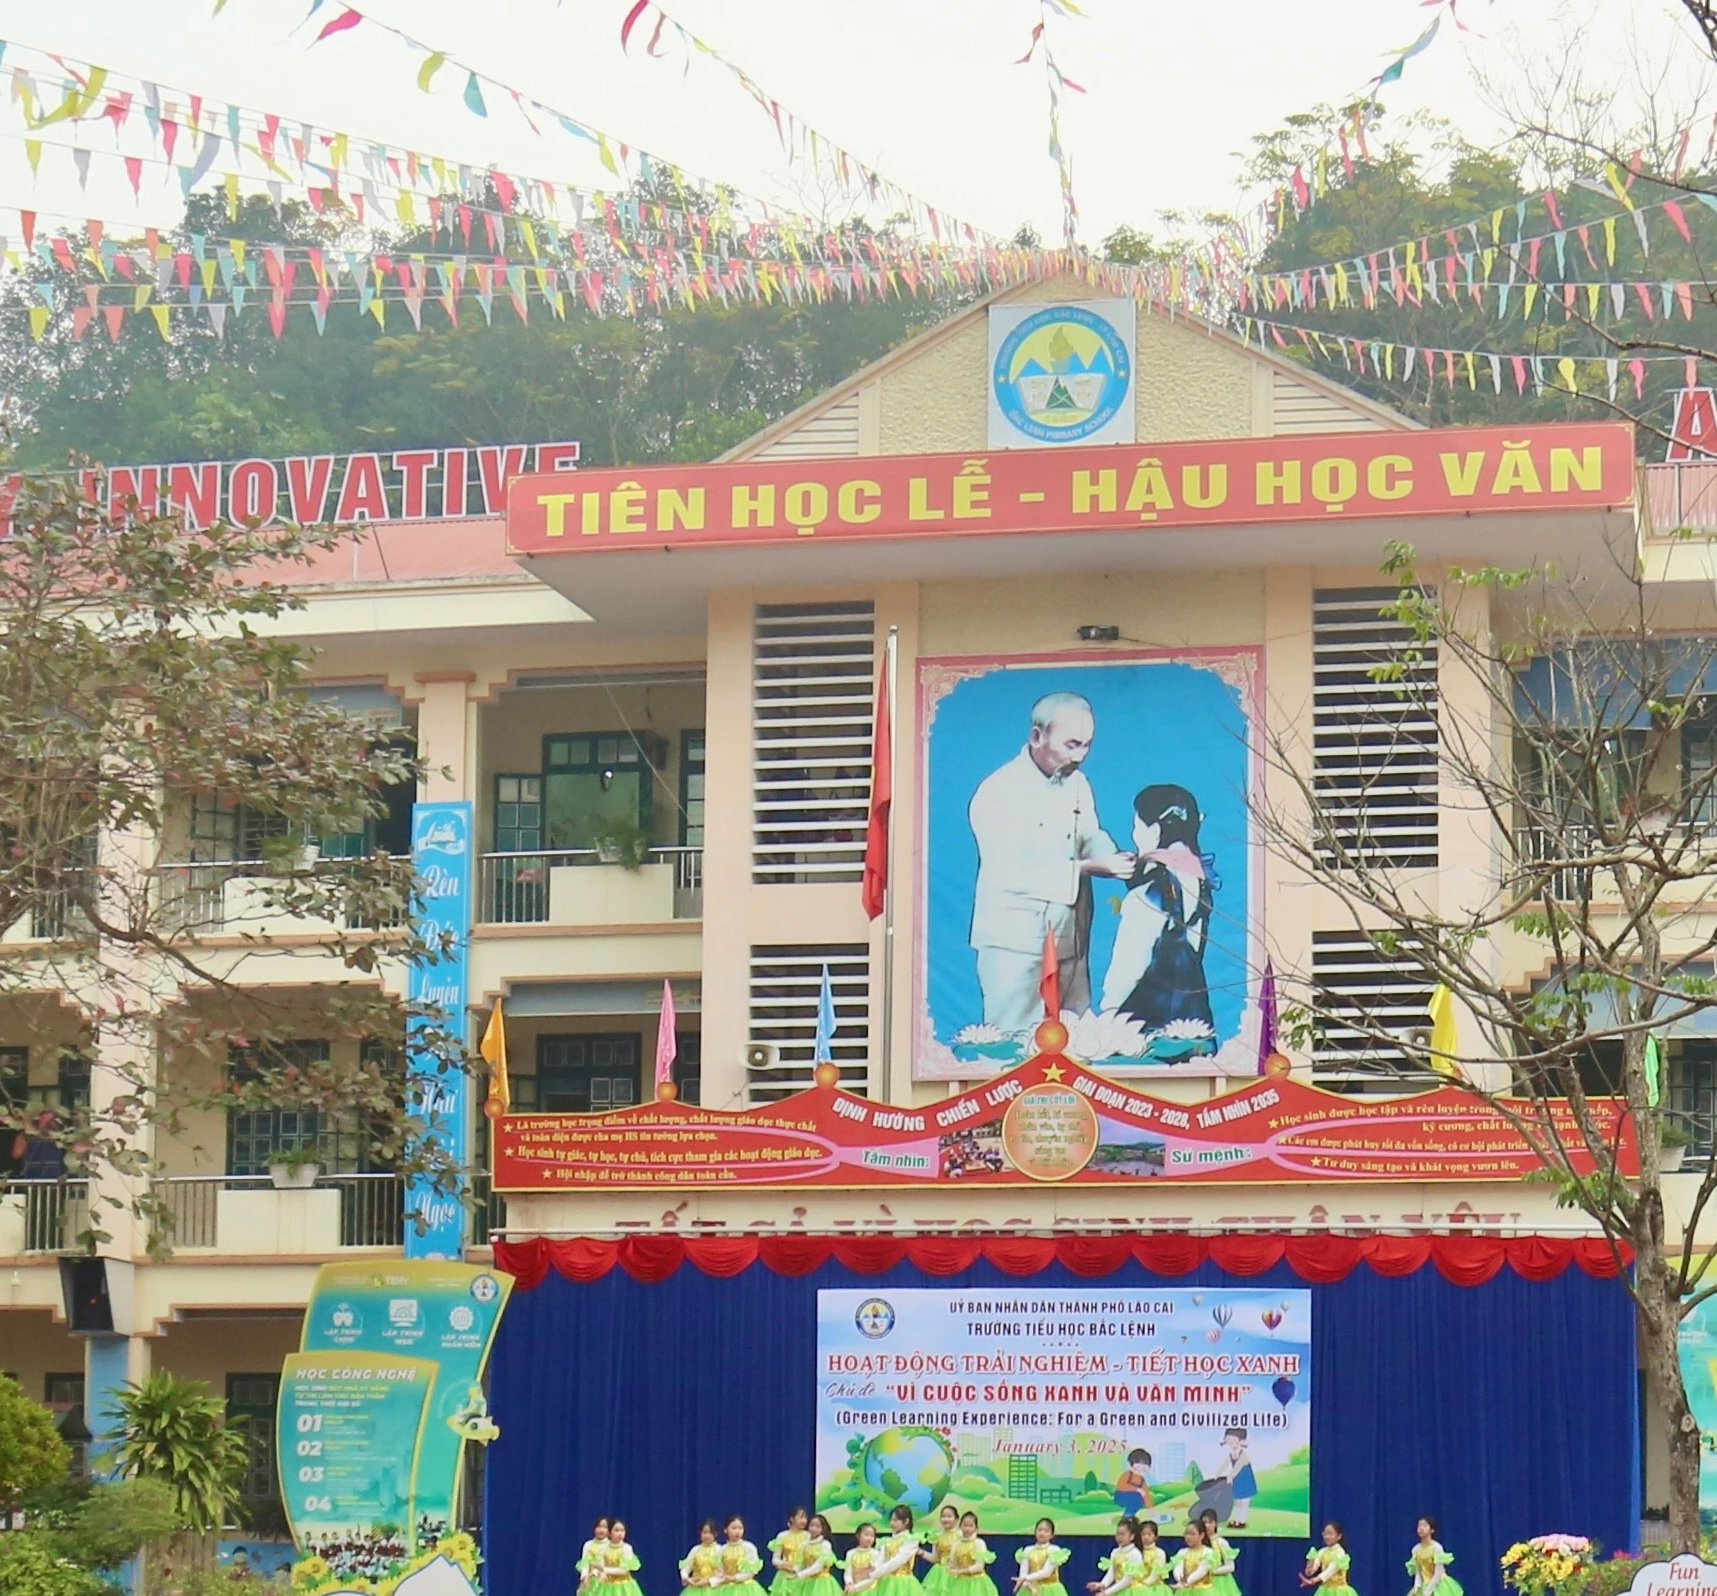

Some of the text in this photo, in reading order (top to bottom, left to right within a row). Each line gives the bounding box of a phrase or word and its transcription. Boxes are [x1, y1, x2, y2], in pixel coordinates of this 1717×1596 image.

[537, 480, 706, 537] TIÊN
[731, 479, 883, 536] HỌC
[908, 458, 993, 521] LỄ
[1071, 457, 1228, 521] HẬU
[1255, 455, 1415, 512] HỌC
[1440, 439, 1603, 497] VĂN
[967, 1301, 992, 1313] BAN
[995, 1299, 1028, 1313] NHÂN
[1032, 1299, 1055, 1313] DÂN
[1059, 1299, 1098, 1313] THÀNH
[1101, 1299, 1125, 1313] PHỐ
[1128, 1299, 1150, 1313] LÀO
[1153, 1302, 1174, 1313] CAI
[967, 1318, 1156, 1339] TRƯỜNG TIỂU HỌC BẮC LỆNH
[828, 1354, 889, 1378] HOẠT
[895, 1350, 956, 1379] ĐỘNG
[962, 1348, 1013, 1373] TRẢI
[1020, 1351, 1108, 1378] NGHIỆM
[1127, 1348, 1180, 1374] TIẾT
[1184, 1354, 1231, 1379] HỌC
[1236, 1354, 1301, 1374] XANH
[295, 1365, 417, 1383] HỌC CÔNG NGHỆ
[923, 1381, 977, 1406] CUỘC
[984, 1379, 1037, 1401] SỐNG
[1044, 1385, 1097, 1401] XANH
[1105, 1382, 1129, 1401] VÀ
[1137, 1383, 1176, 1401] VĂN
[296, 1413, 323, 1433] 01
[836, 1411, 1288, 1428] (Green Learning Experience: For a Green and Civilized Life)
[296, 1440, 322, 1457] 02
[991, 1439, 1128, 1458] January 3, 2025
[298, 1466, 325, 1483] 03
[304, 1495, 332, 1512] 04
[1668, 1561, 1700, 1581] Fun
